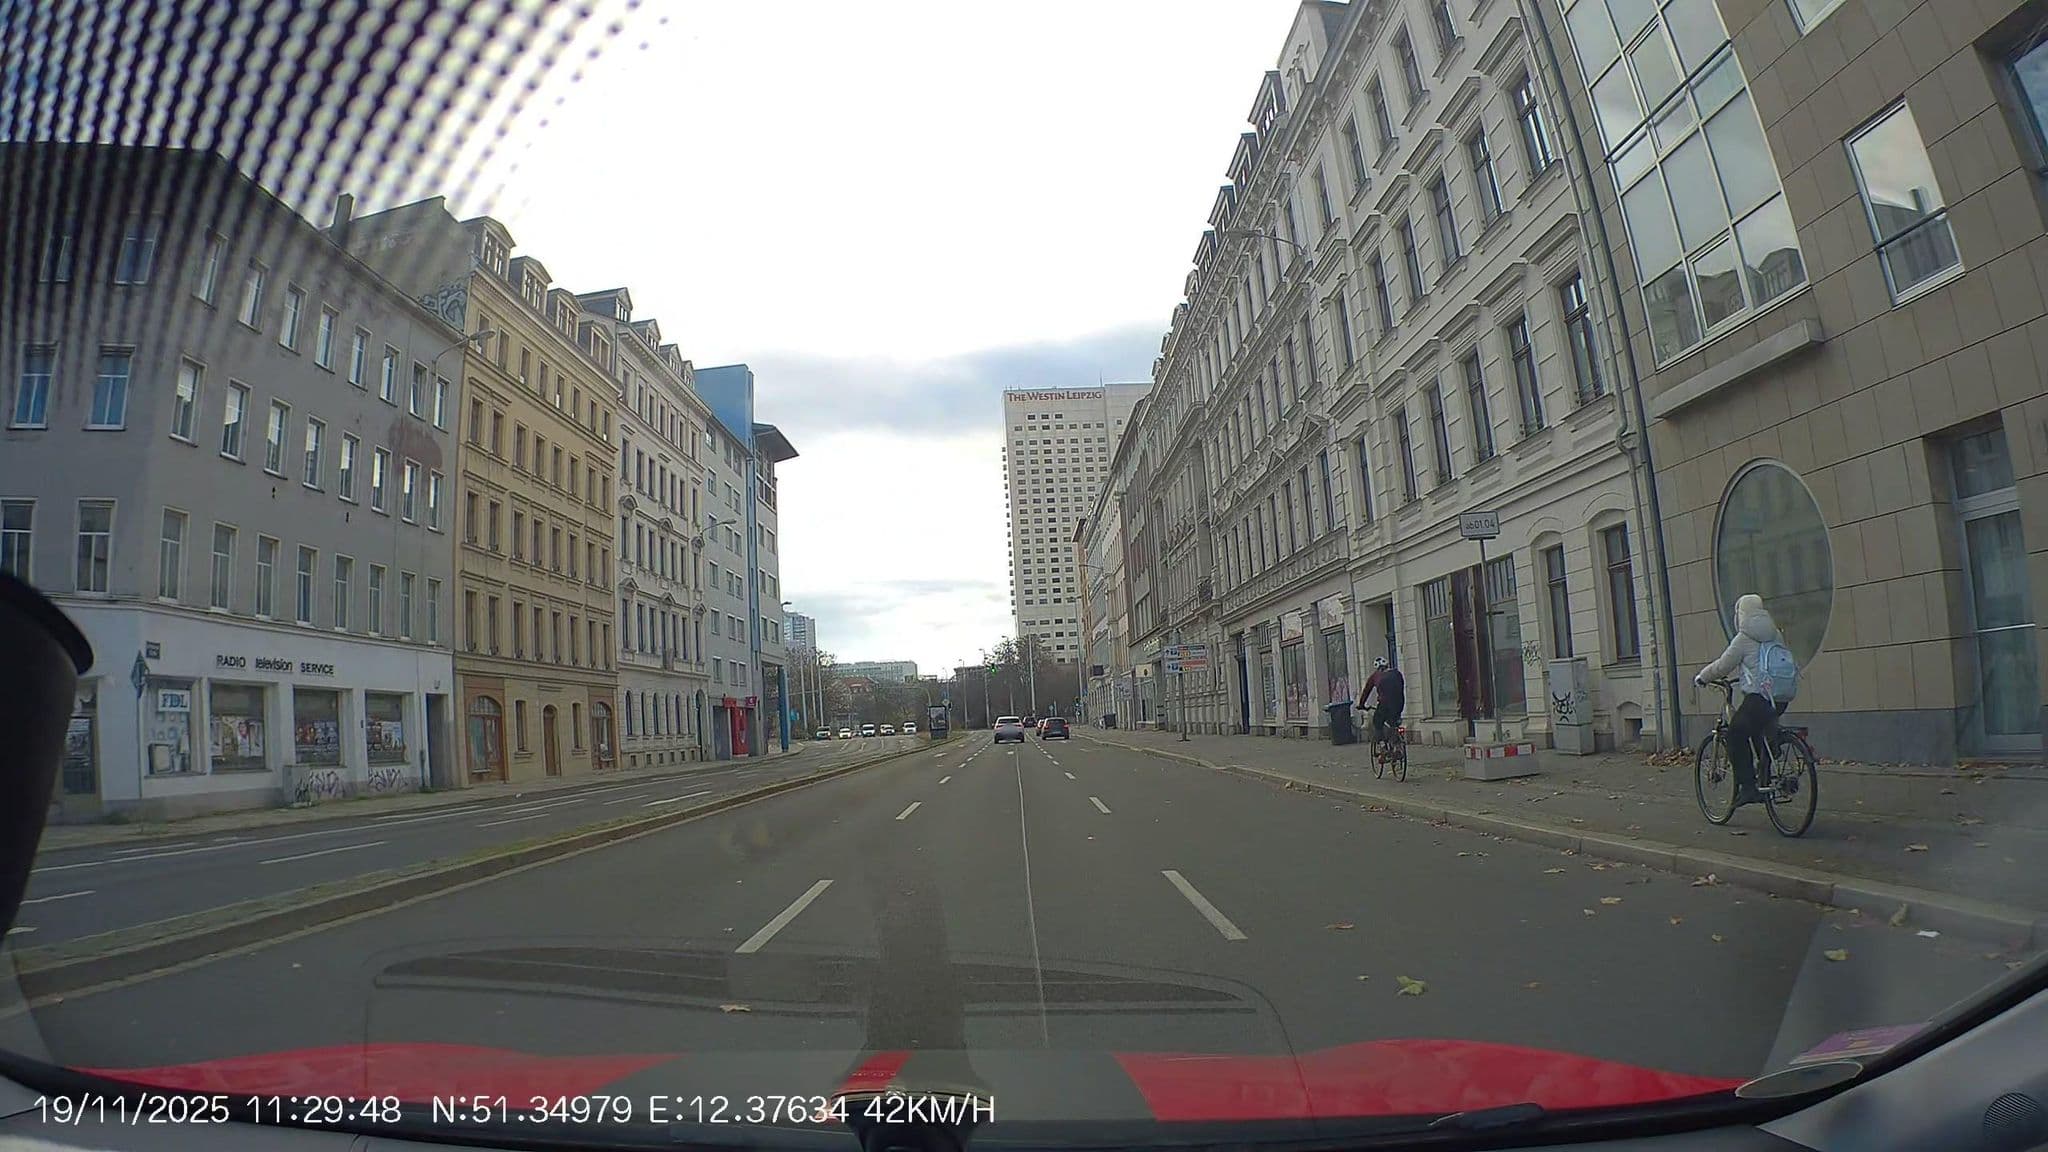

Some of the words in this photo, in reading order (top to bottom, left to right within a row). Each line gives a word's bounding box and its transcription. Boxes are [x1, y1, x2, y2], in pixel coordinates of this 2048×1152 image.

[1006, 392, 1027, 402] THE
[1027, 391, 1065, 401] WESTIN
[1066, 390, 1102, 400] LEIPZIG
[216, 654, 247, 668] RADIO
[255, 657, 294, 671] television
[300, 662, 335, 675] SERVICE
